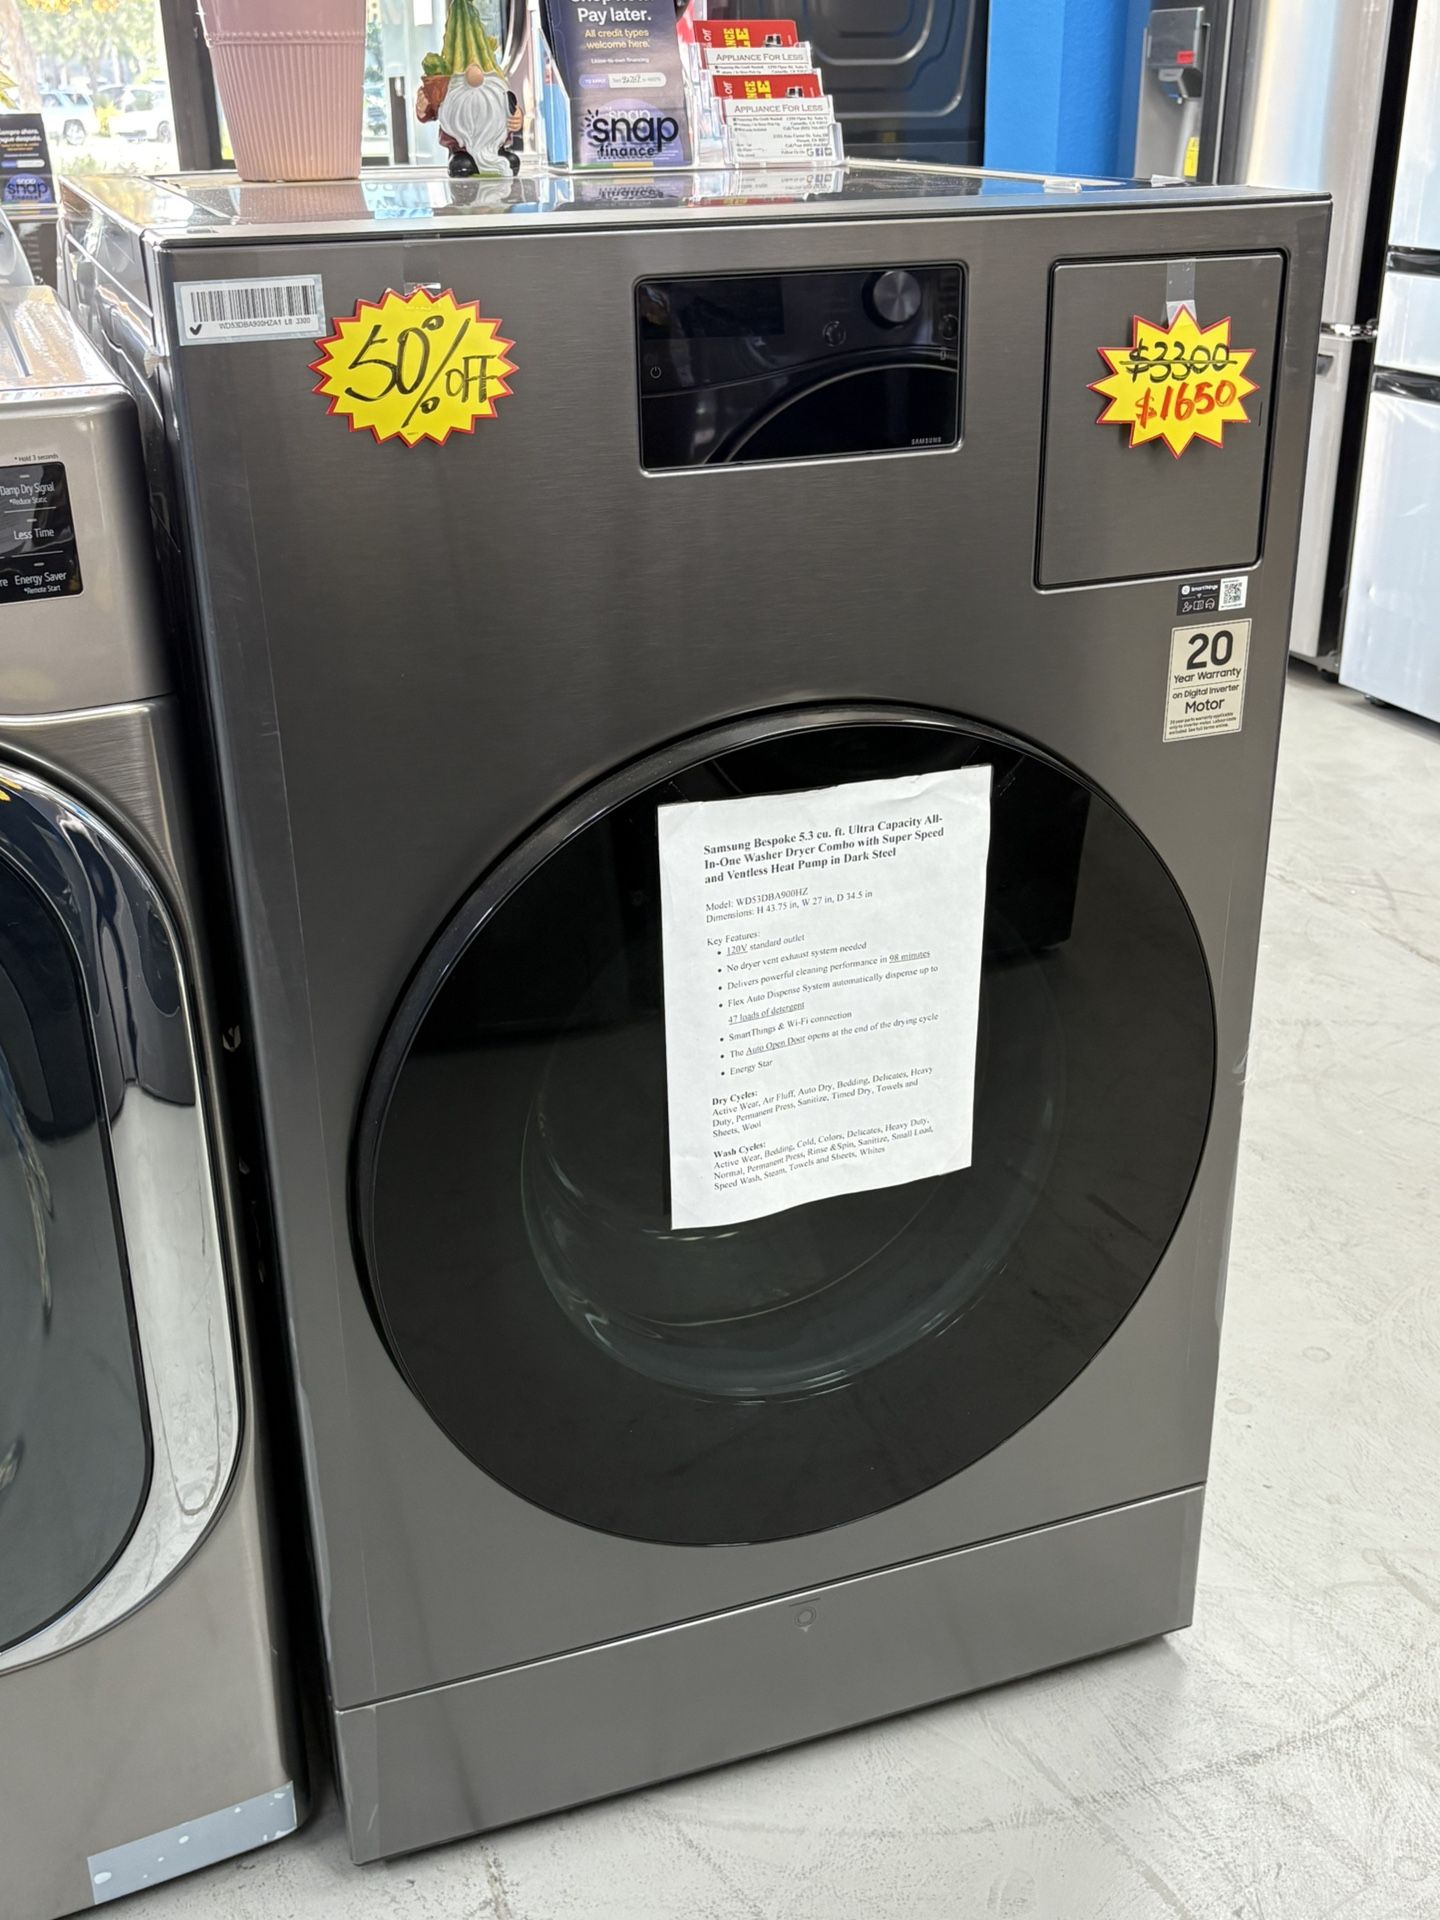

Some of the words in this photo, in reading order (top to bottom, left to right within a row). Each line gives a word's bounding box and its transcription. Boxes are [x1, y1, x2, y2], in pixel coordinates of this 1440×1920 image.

[577, 8, 607, 25] Pay
[610, 7, 651, 21] later.
[586, 40, 626, 49] welcome
[598, 29, 623, 37] credit
[625, 29, 649, 38] types
[593, 117, 679, 152] snap
[600, 145, 654, 157] finance
[345, 315, 471, 428] 50%
[1126, 338, 1230, 383] $3300
[1135, 380, 1237, 429] $1650
[912, 437, 942, 445] SAMSUNG
[0, 486, 20, 497] Damp
[21, 484, 33, 495] Dry
[34, 481, 55, 495] Signal
[14, 530, 33, 540] Less
[35, 527, 54, 538] Time
[14, 575, 42, 586] Energy
[44, 572, 67, 582] Saver
[1186, 630, 1233, 670] 20
[1174, 674, 1195, 683] Year
[1197, 668, 1242, 680] Warranty
[1184, 688, 1208, 698] Digital
[1209, 684, 1239, 694] Inverter
[1185, 699, 1225, 714] Motor
[704, 841, 751, 855] Samsung
[754, 834, 796, 848] Bespoke
[799, 830, 813, 842] 5.3
[816, 830, 832, 839] cu.
[835, 827, 845, 836] ft.
[849, 824, 874, 834] Ultra
[878, 817, 922, 831] Capacity
[924, 814, 942, 825] All-
[705, 857, 741, 869] In-One
[744, 850, 783, 862] Washer
[785, 846, 815, 857] Dryer
[818, 840, 855, 852] Combo
[858, 836, 879, 846] with
[882, 833, 912, 845] Super
[915, 827, 944, 842] Speed
[705, 872, 724, 884] and
[727, 867, 768, 880] Ventless
[771, 862, 794, 873] Heat
[798, 859, 828, 869] Pump
[831, 856, 840, 865] in
[844, 851, 869, 863] Dark
[872, 847, 896, 859] Steel
[705, 901, 734, 911] Model:
[736, 887, 809, 906] WD53DBA900HZ
[706, 908, 755, 923] Dimensions:
[756, 906, 764, 914] H
[766, 901, 787, 913] 43.75
[789, 901, 799, 910] in,
[802, 899, 810, 907] W
[812, 897, 822, 905] 27
[825, 895, 835, 904] in,
[837, 893, 844, 902] D
[847, 891, 863, 900] 34.5
[865, 890, 873, 898] in
[707, 938, 723, 946] Key
[725, 931, 760, 943] Features:
[727, 944, 748, 956] 120V
[750, 937, 781, 950] standard
[784, 934, 805, 944] outlet
[727, 964, 738, 972] No
[741, 960, 760, 970] dryer
[763, 957, 779, 965] vent
[781, 951, 809, 962] exhaust
[811, 947, 837, 958] system
[840, 941, 867, 953] needed
[727, 980, 759, 990] Delivers
[761, 970, 794, 985] powerful
[796, 965, 828, 976] cleaning
[830, 958, 878, 972] performance
[880, 955, 887, 963] in
[889, 954, 899, 963] 98
[901, 950, 930, 961] minutes
[728, 999, 744, 1007] Flex
[747, 995, 765, 1003] Auto
[767, 987, 800, 999] Dispense
[803, 981, 830, 993] System
[832, 972, 883, 988] automatically
[885, 969, 918, 979] dispense
[920, 967, 929, 975] up
[728, 1015, 738, 1025] 47
[739, 1011, 760, 1023] loads
[761, 1008, 770, 1018] of
[771, 1002, 805, 1016] detergent
[729, 1026, 776, 1041] SmartThings
[787, 1017, 809, 1028] Wi-Fi
[810, 1011, 852, 1023] connection
[731, 1050, 744, 1058] The
[746, 1045, 764, 1056] Auto
[766, 1039, 785, 1052] Open
[787, 1035, 806, 1046] Door
[808, 1031, 829, 1041] opens
[832, 1029, 839, 1037] at
[841, 1027, 852, 1036] the
[854, 1025, 868, 1033] end
[870, 1022, 879, 1031] of
[880, 1020, 892, 1029] the
[893, 1017, 917, 1028] drying
[919, 1012, 939, 1023] cycle
[730, 1064, 756, 1075] Energy
[758, 1059, 773, 1069] Star
[712, 1106, 738, 1116] Active
[740, 1100, 760, 1110] Wear,
[763, 1097, 774, 1105] Air
[776, 1089, 796, 1101] Fluff,
[798, 1087, 816, 1096] Auto
[818, 1083, 835, 1093] Dry,
[837, 1078, 870, 1089] Bedding,
[872, 1071, 908, 1083] Delicates,
[911, 1066, 933, 1077] Heavy
[712, 1097, 727, 1106] Dry
[730, 1090, 757, 1103] Cycles:
[713, 1127, 740, 1138] Sheets,
[742, 1120, 761, 1131] Wool
[713, 1148, 736, 1158] Wash
[739, 1142, 766, 1155] Cycles:
